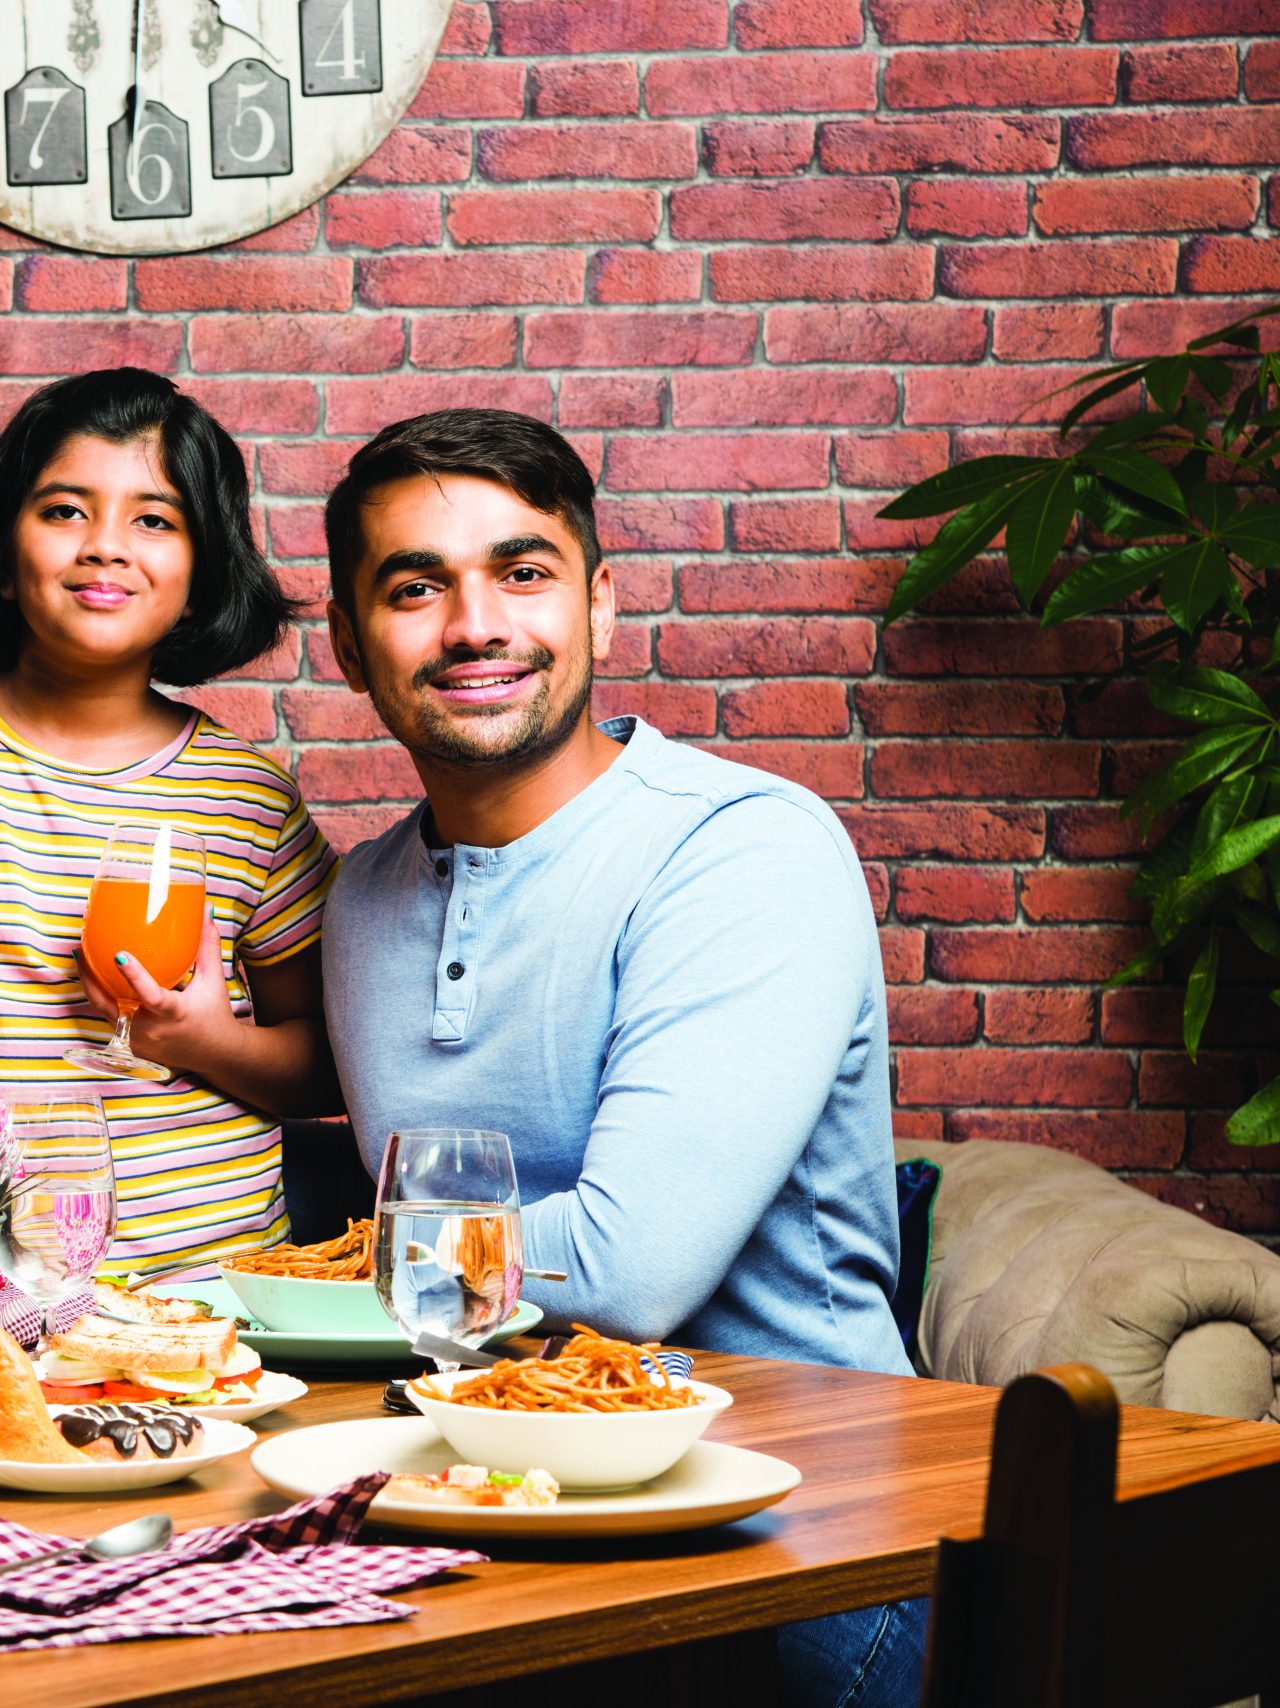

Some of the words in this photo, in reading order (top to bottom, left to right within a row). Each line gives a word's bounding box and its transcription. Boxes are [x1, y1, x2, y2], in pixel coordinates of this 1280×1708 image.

[314, 0, 366, 80] 4
[20, 87, 72, 170] 7
[226, 80, 276, 163] 5
[126, 122, 174, 205] 6
